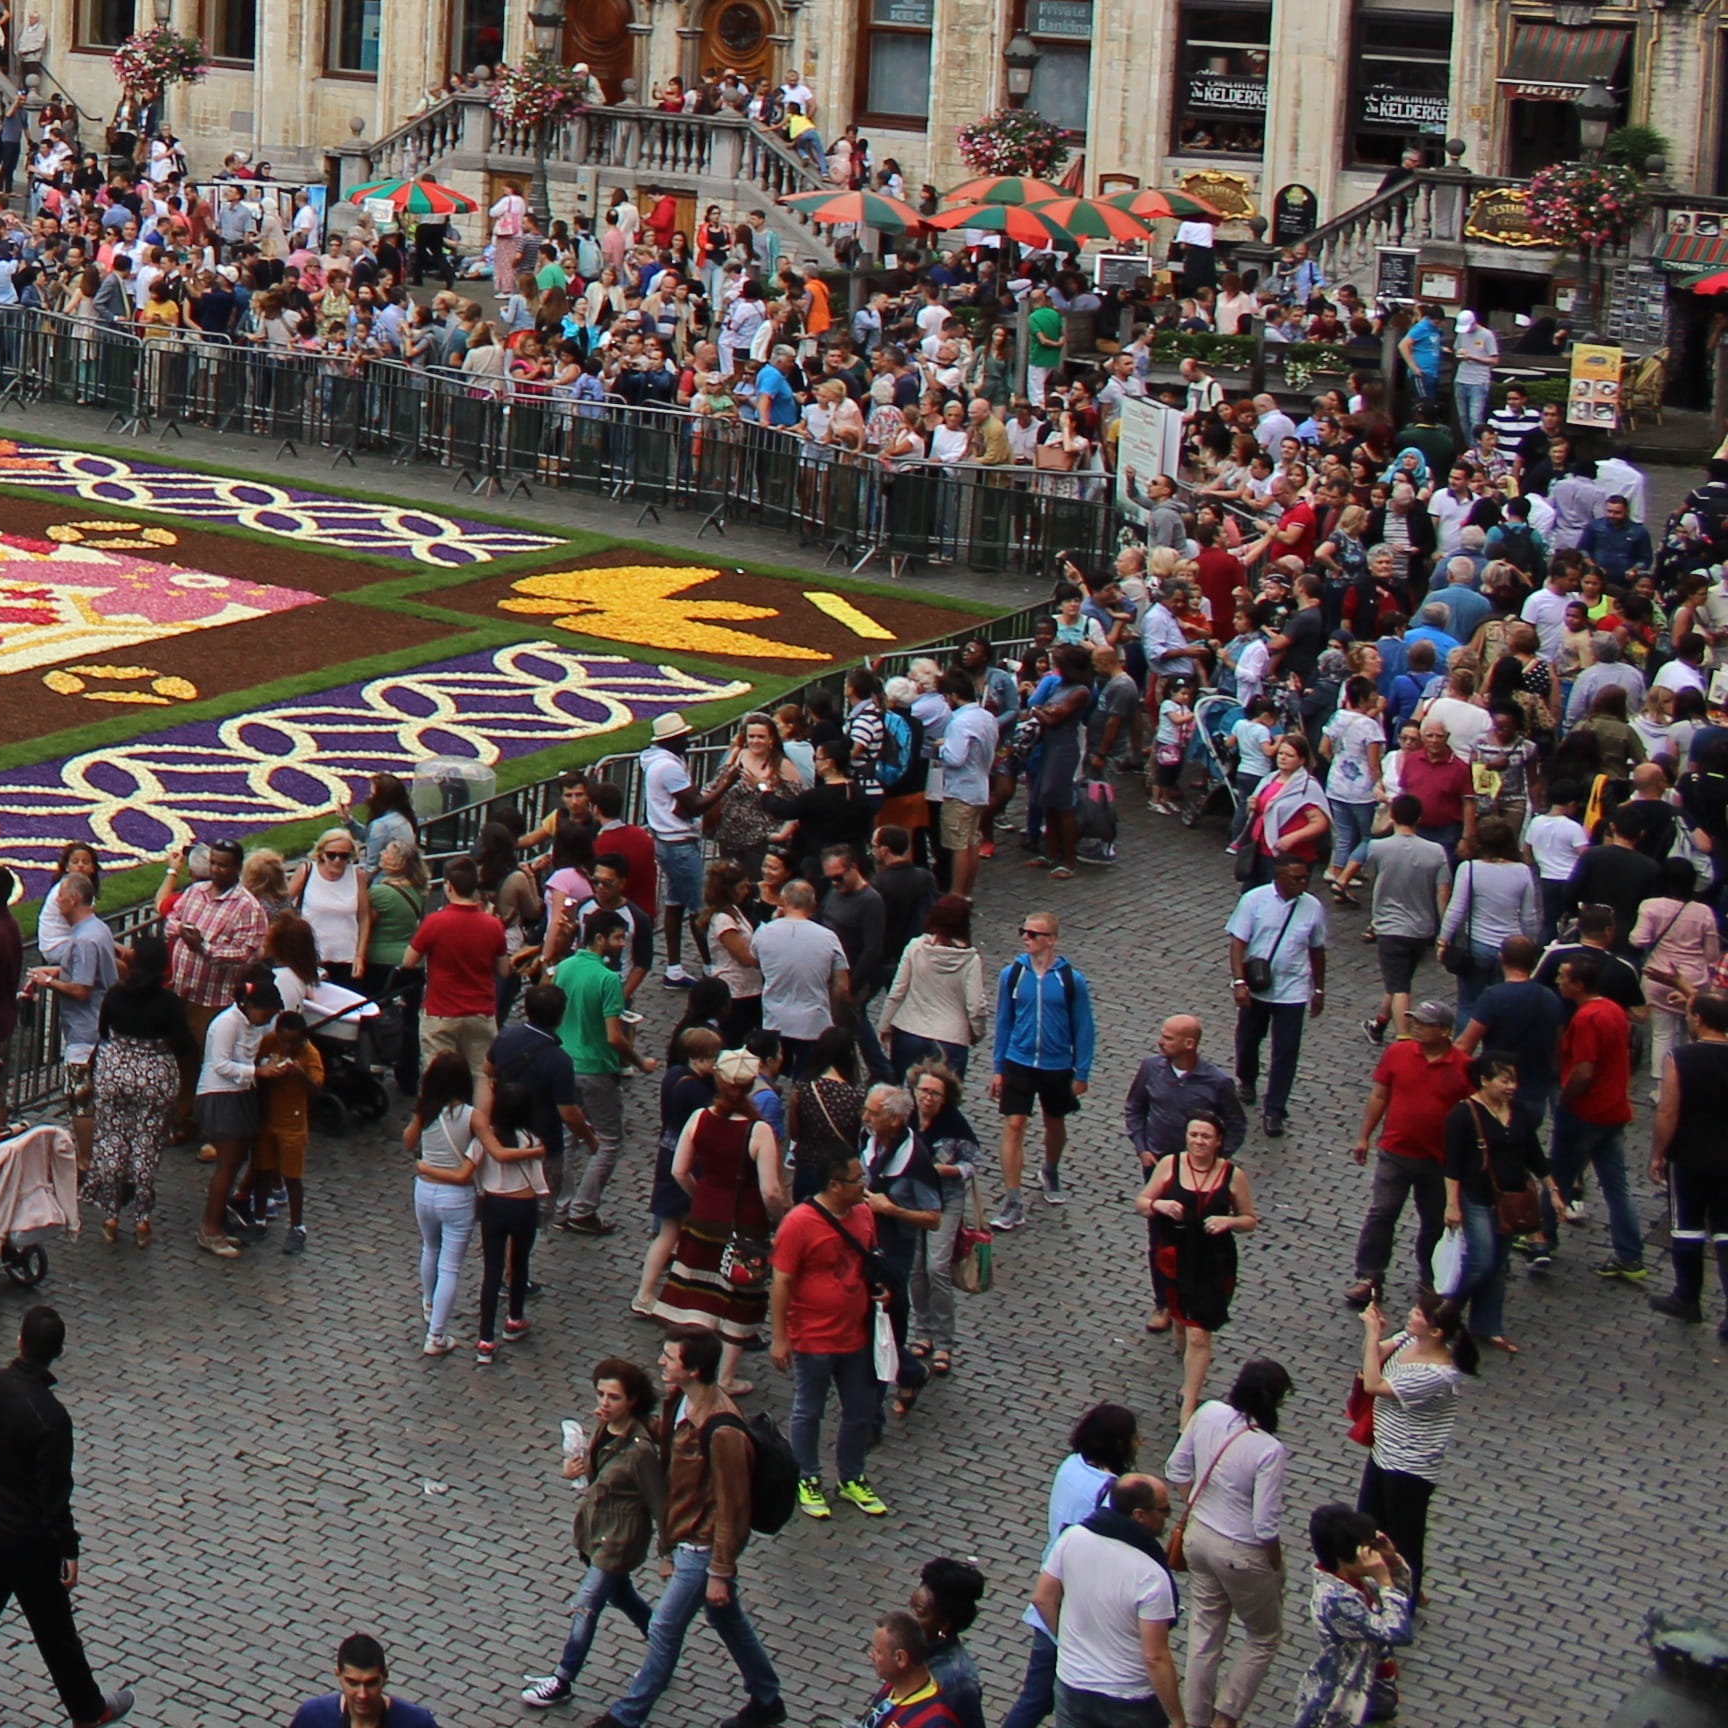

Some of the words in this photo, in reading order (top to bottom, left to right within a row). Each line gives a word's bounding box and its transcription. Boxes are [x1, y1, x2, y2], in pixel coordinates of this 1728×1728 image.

[890, 10, 926, 22] KBC
[1038, 2, 1087, 17] Private
[1037, 18, 1091, 34] Banking
